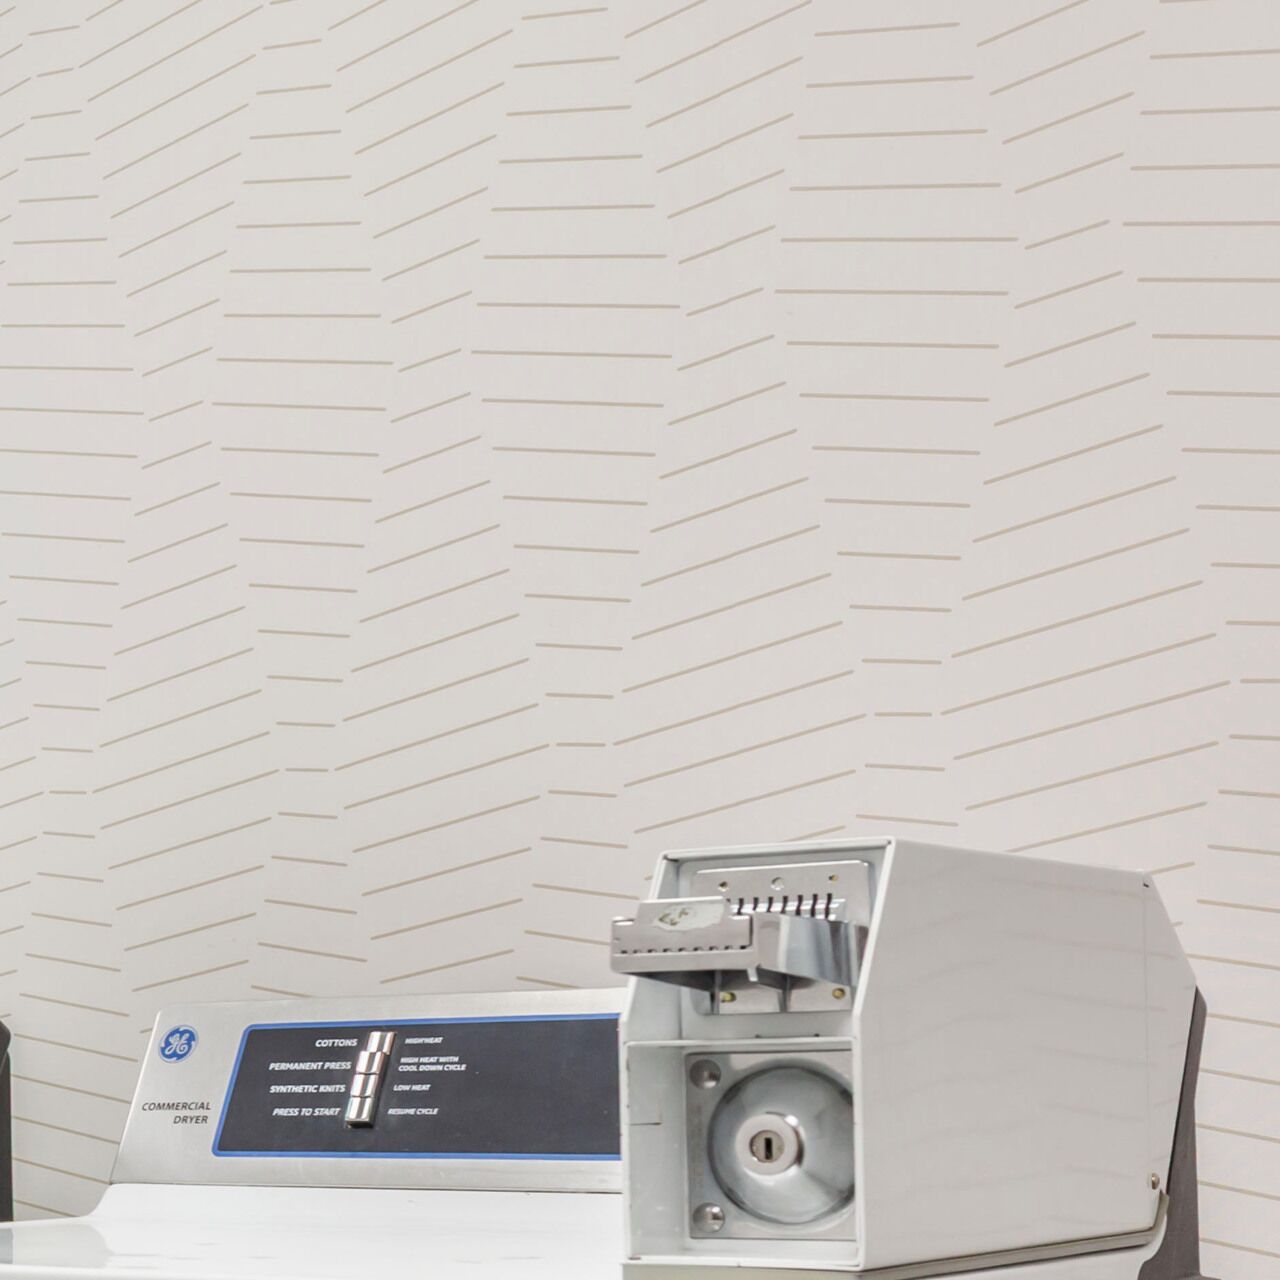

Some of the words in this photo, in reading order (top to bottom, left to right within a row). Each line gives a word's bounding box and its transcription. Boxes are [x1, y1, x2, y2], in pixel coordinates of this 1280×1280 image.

[315, 1038, 358, 1048] COTTONS
[268, 1062, 323, 1071] PERMANENT
[323, 1061, 352, 1070] PRESS
[269, 1085, 318, 1094] SYNTHETIC
[319, 1084, 346, 1093] KNITS
[141, 1102, 211, 1111] COMMERCIAL
[416, 1107, 439, 1115] CYCLE
[272, 1108, 299, 1116] PRESS
[300, 1108, 313, 1116] TO
[313, 1107, 341, 1116] START
[173, 1115, 209, 1124] DRYER
